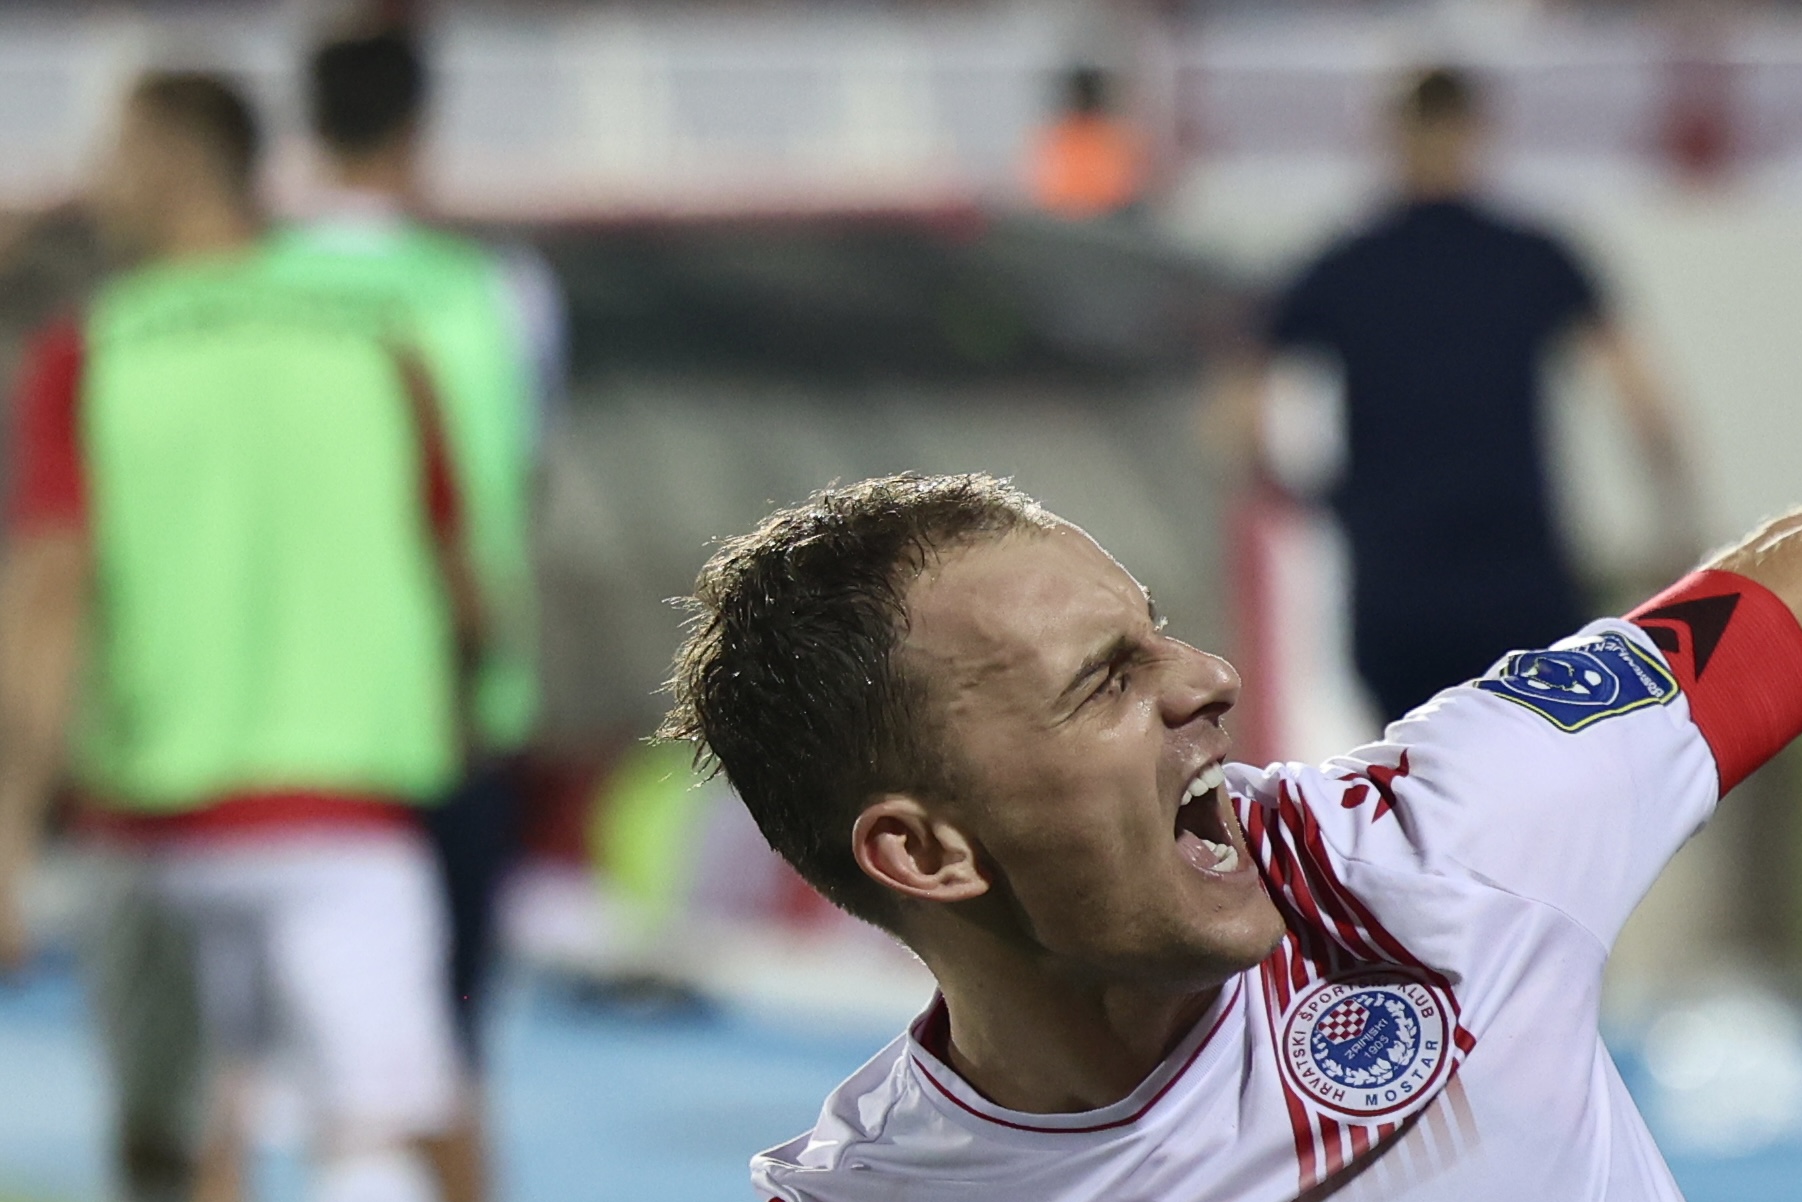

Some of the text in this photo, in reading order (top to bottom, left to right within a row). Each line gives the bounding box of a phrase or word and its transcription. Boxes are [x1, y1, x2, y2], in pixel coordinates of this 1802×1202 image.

[1292, 978, 1435, 1102] HRVATSKI ŠPORT KLUB
[1363, 1034, 1391, 1060] 1905
[1365, 1039, 1440, 1107] MOSTAR
